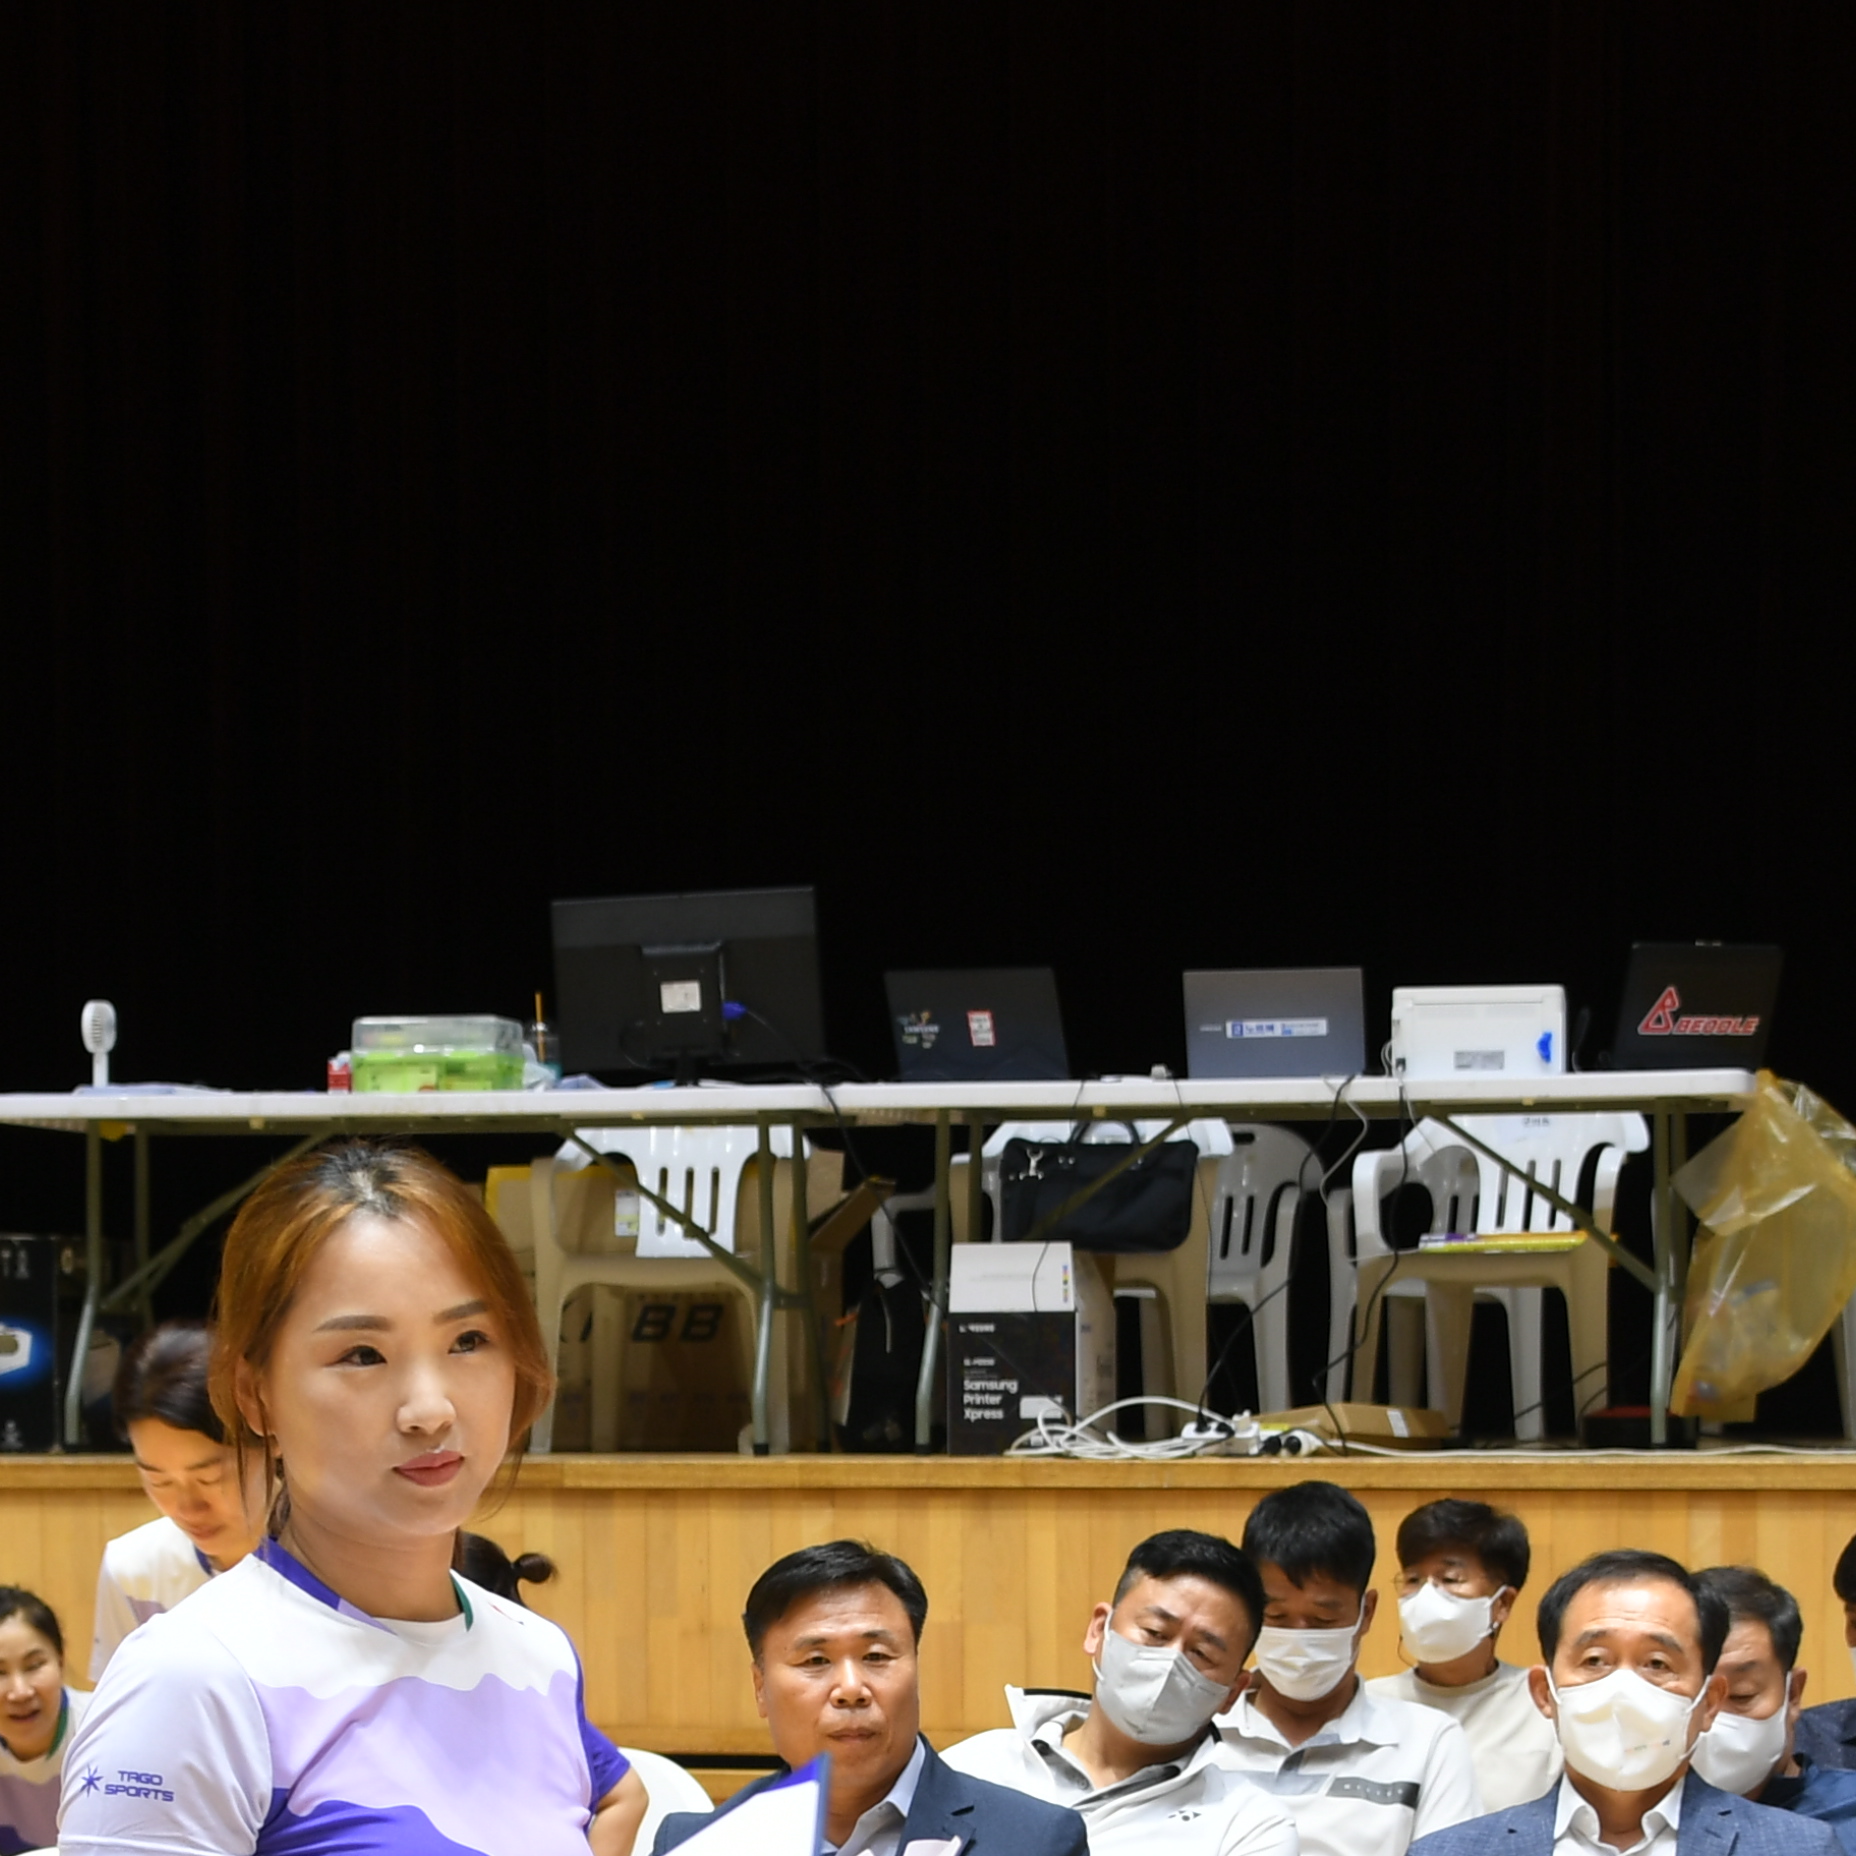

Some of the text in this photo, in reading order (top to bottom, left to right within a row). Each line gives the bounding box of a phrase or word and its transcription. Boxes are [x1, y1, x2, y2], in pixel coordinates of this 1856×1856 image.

[963, 1379, 1019, 1394] Samsung
[963, 1393, 1003, 1406] Printer
[963, 1407, 1005, 1422] Xpress
[105, 1784, 174, 1801] SPORTS
